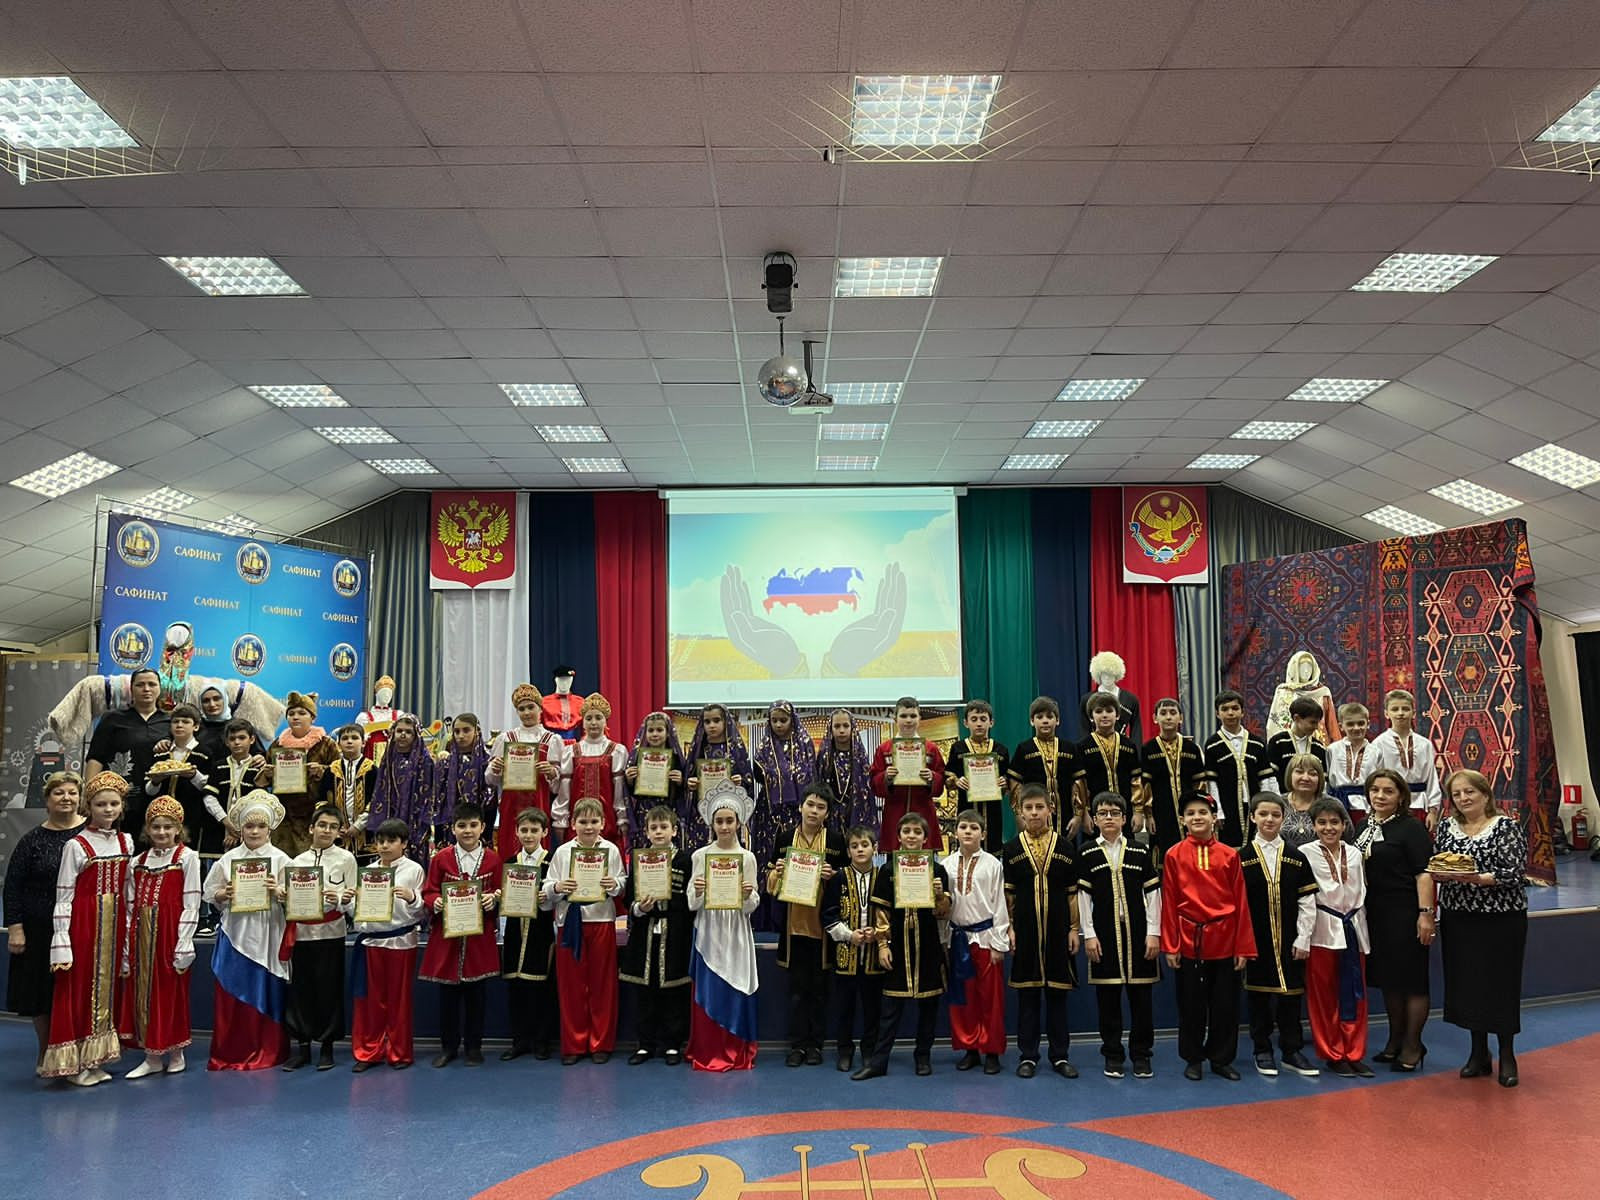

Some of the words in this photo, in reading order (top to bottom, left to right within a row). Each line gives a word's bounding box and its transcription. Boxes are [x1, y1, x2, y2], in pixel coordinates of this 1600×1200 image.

[174, 545, 223, 562] САФИНАТ
[282, 564, 322, 578] САФИНАТ
[115, 586, 168, 601] САФИНАТ
[193, 596, 240, 610] САФИНАТ
[262, 604, 304, 617] САФИНАТ
[322, 612, 359, 624] САФИНАТ
[319, 699, 356, 708] САФИНАТ
